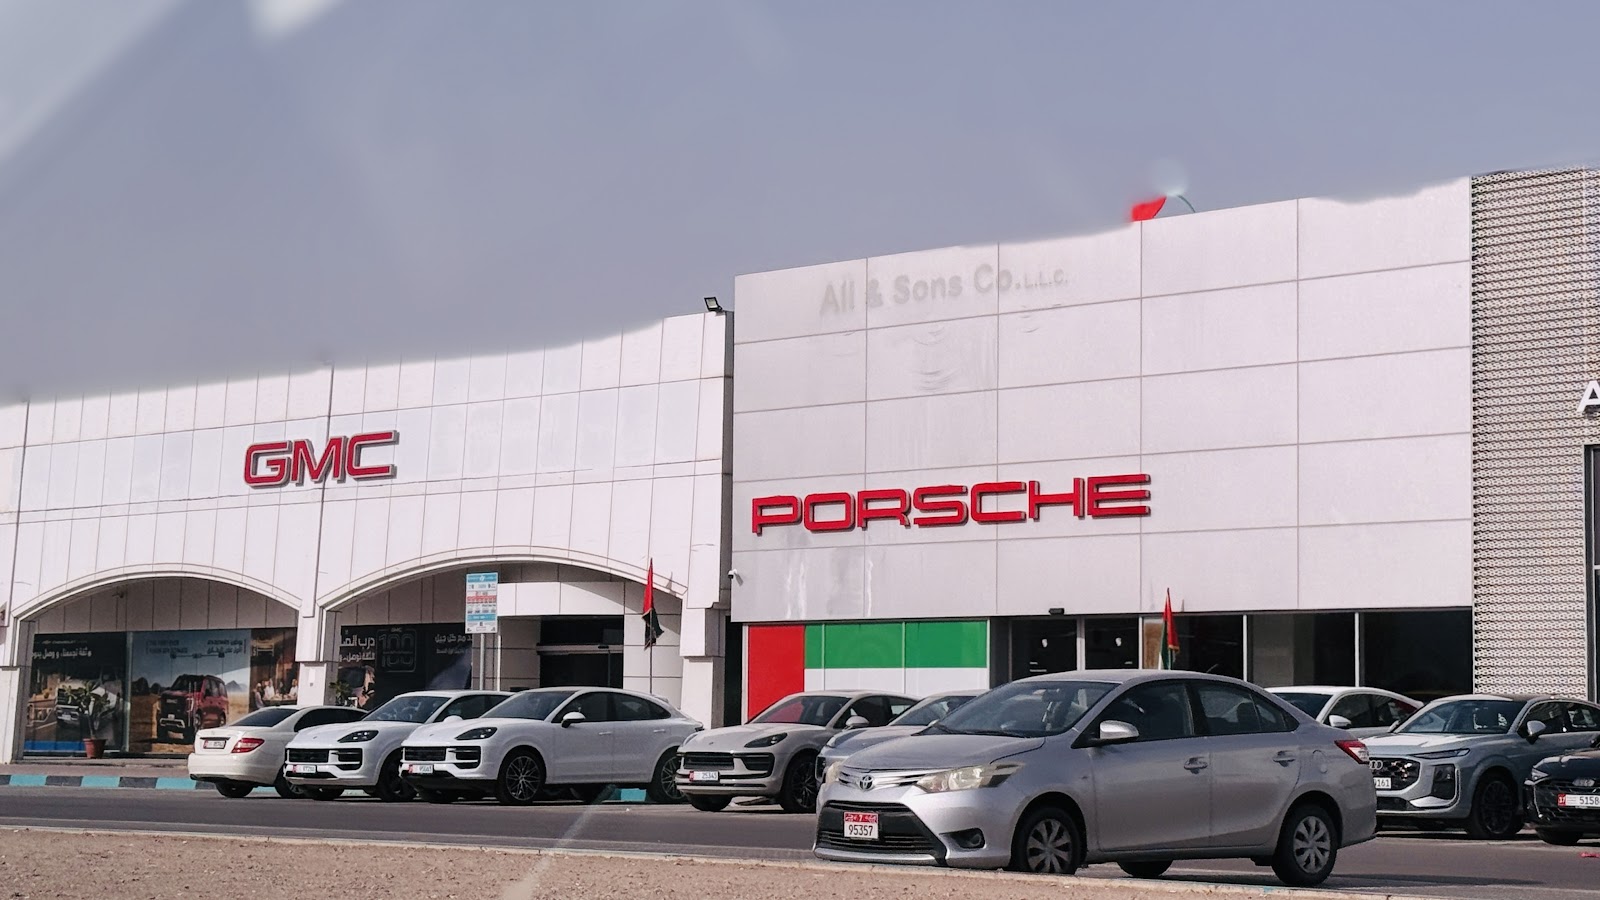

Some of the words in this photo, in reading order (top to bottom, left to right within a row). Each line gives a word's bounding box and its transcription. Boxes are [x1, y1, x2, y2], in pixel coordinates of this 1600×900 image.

[866, 278, 884, 308] &
[893, 274, 963, 304] Sons
[243, 430, 400, 490] GMC
[752, 474, 1151, 535] PORSCHE
[848, 824, 874, 837] 95357
